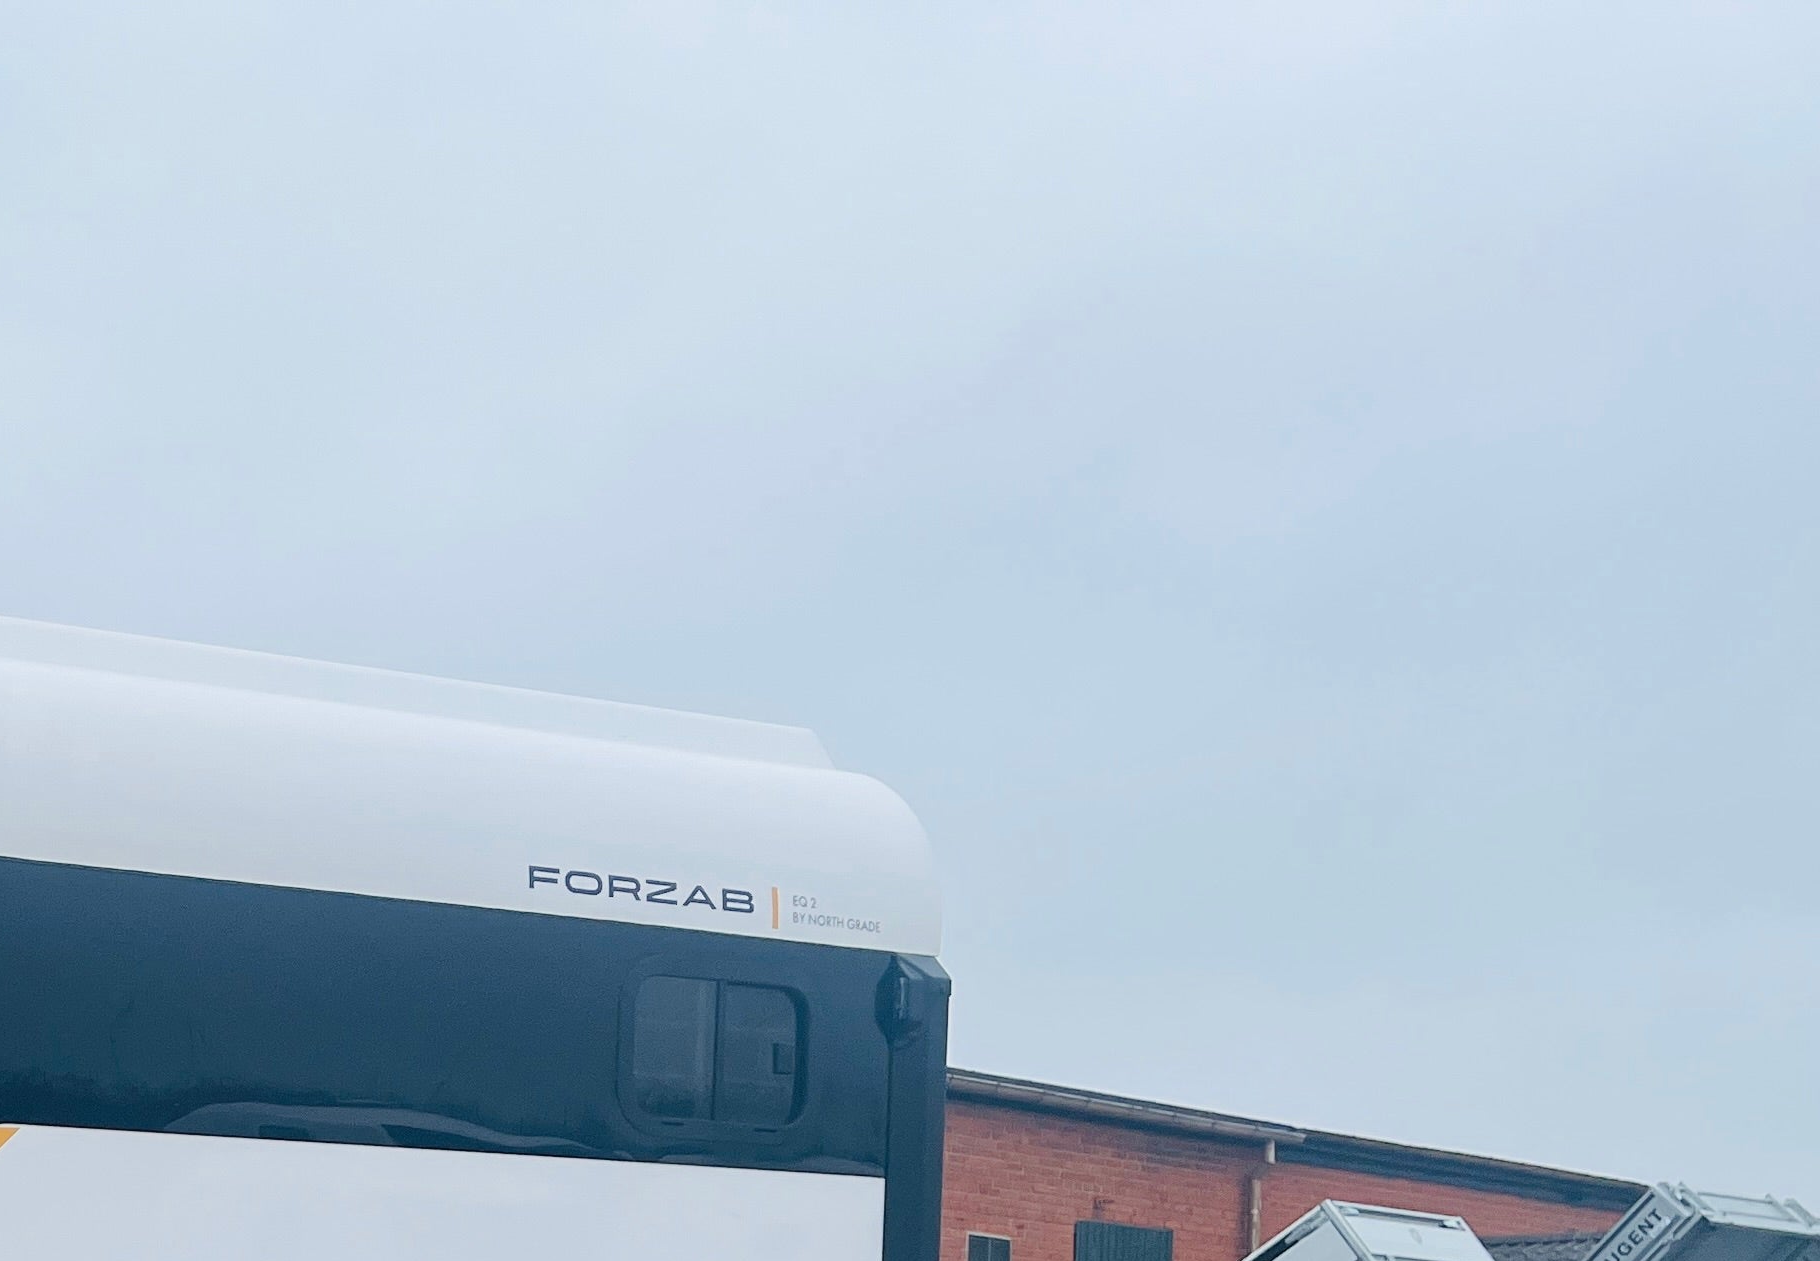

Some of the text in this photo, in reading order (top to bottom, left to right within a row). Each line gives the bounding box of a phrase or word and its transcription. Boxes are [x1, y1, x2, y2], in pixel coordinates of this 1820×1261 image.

[528, 865, 755, 914] FORZAB
[792, 895, 817, 909] EQ 2
[792, 911, 882, 934] BY NORTH GRADE
